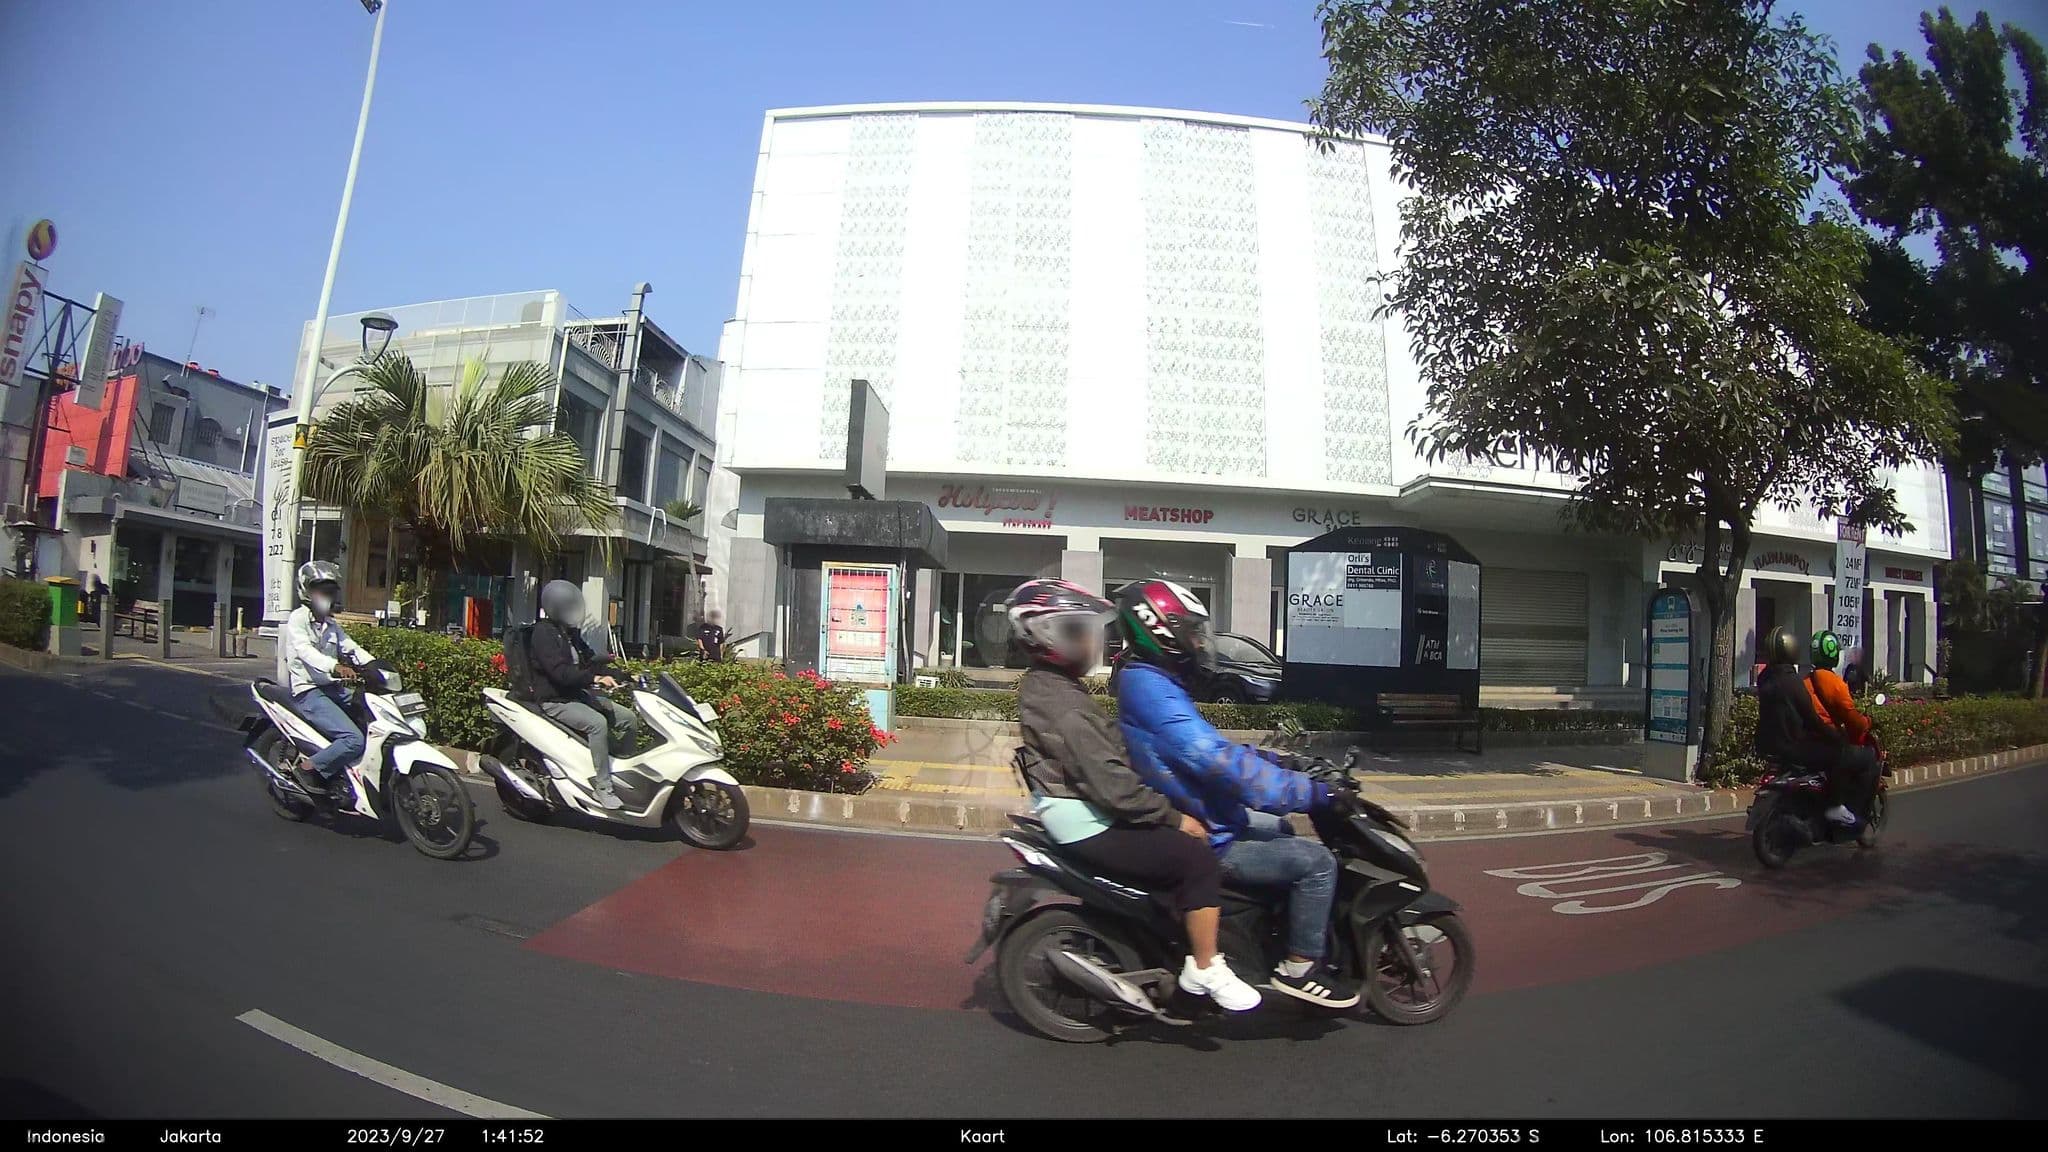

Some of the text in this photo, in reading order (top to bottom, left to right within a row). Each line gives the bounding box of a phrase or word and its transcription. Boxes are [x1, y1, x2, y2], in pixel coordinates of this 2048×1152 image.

[1124, 504, 1215, 524] MEATSHOP
[1292, 508, 1361, 525] GRACE
[1347, 566, 1399, 575] Dental Clinic
[1289, 593, 1344, 608] GRACE
